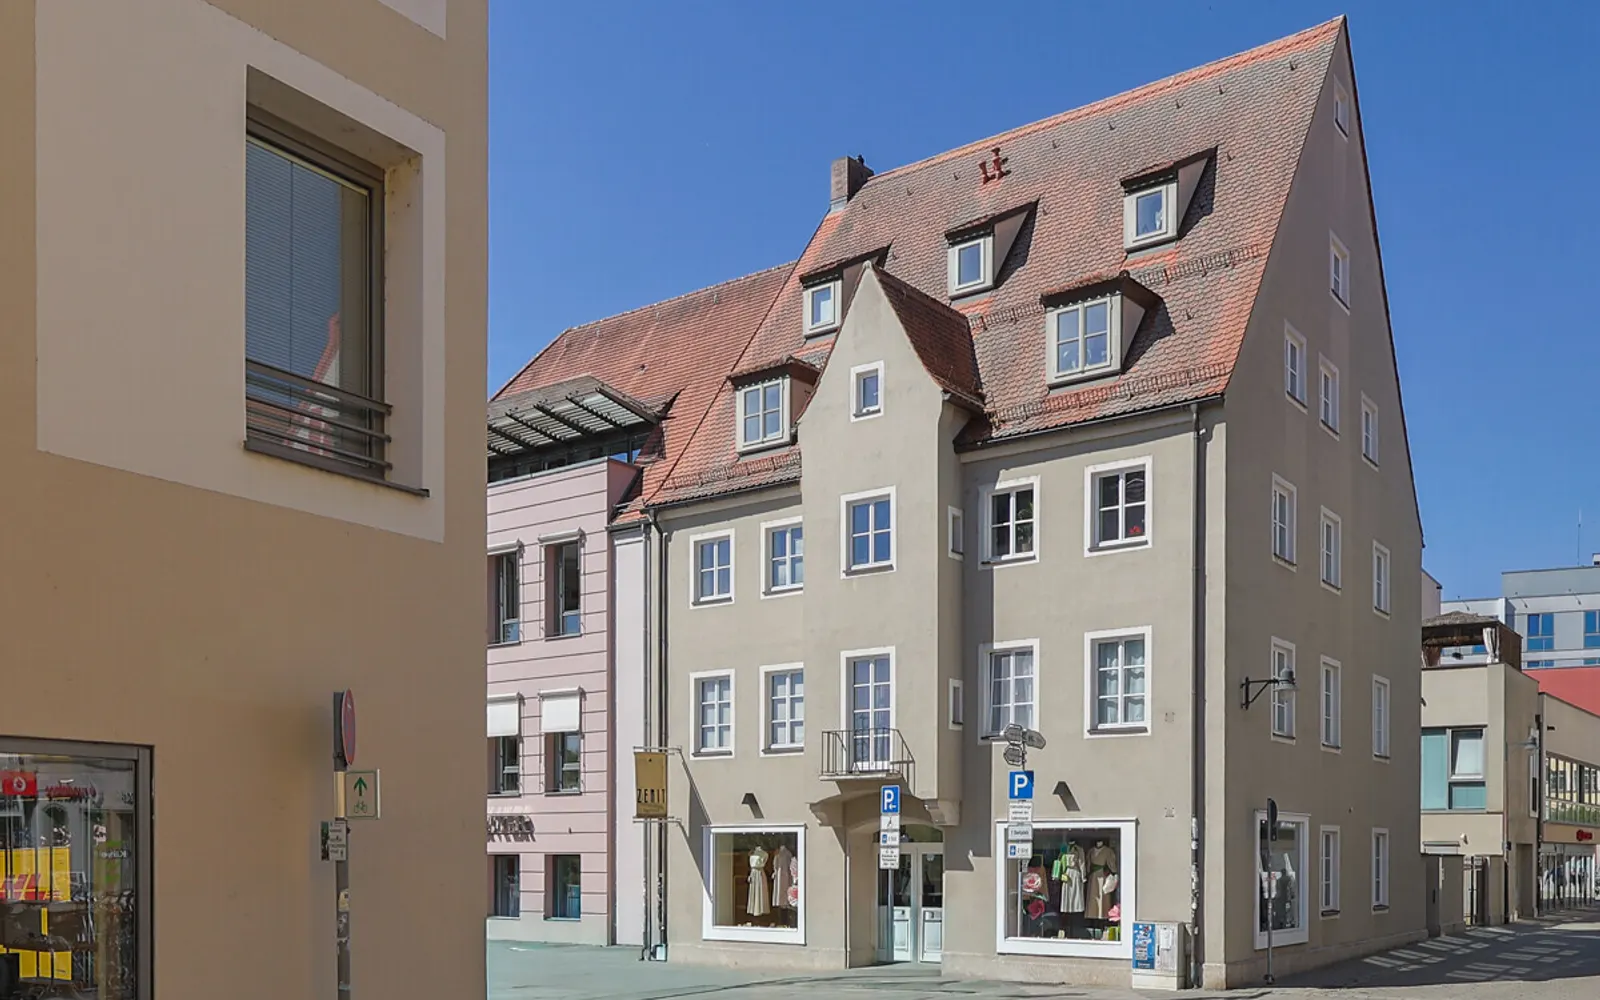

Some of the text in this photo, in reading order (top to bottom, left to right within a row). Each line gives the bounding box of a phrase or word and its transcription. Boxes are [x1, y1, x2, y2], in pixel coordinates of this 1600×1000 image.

[636, 788, 666, 804] ZENIT
[1014, 774, 1028, 797] P
[884, 789, 894, 811] P
